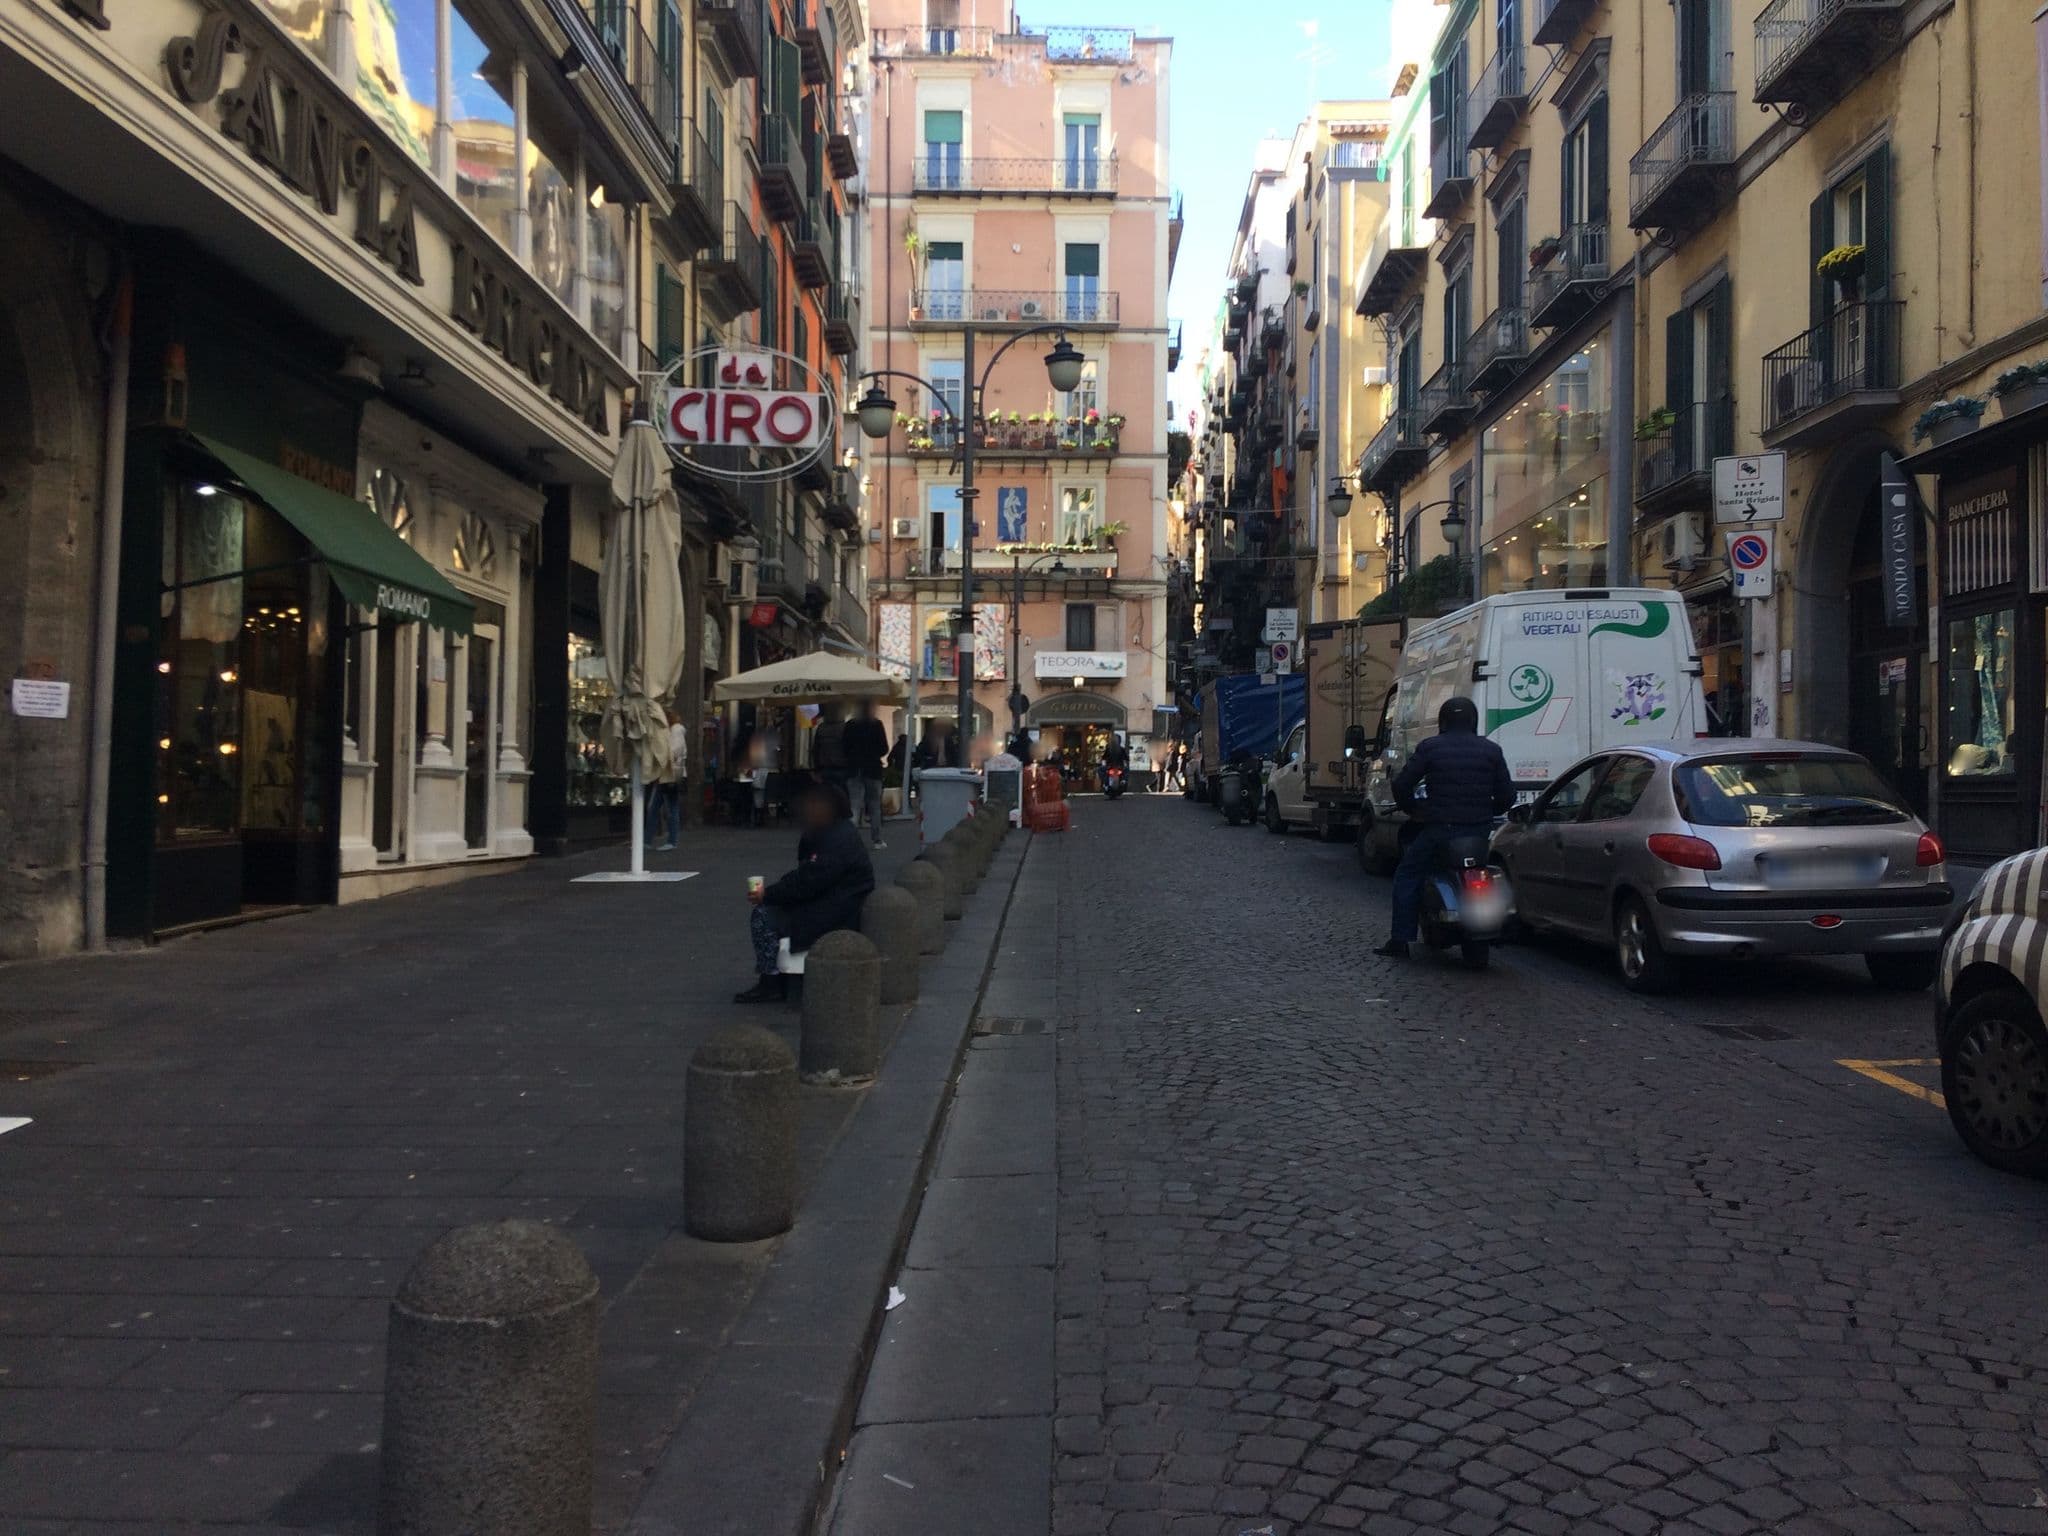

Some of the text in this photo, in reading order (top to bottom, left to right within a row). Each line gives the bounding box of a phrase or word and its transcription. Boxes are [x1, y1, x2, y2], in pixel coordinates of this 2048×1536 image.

[166, 12, 610, 436] SANTA BRIGIDA
[670, 391, 813, 444] CIRO
[1719, 495, 1780, 506] Santa Brigida
[1735, 489, 1763, 497] Hotel
[1948, 488, 2009, 522] BIANCHERIA
[1891, 513, 1913, 618] MONDO CASA
[376, 583, 431, 619] ROMANO
[1522, 611, 1563, 622] RITIRO
[1586, 608, 1640, 620] ESAUSTI
[1522, 624, 1582, 636] VEGETALI
[1040, 656, 1096, 667] TEDORA
